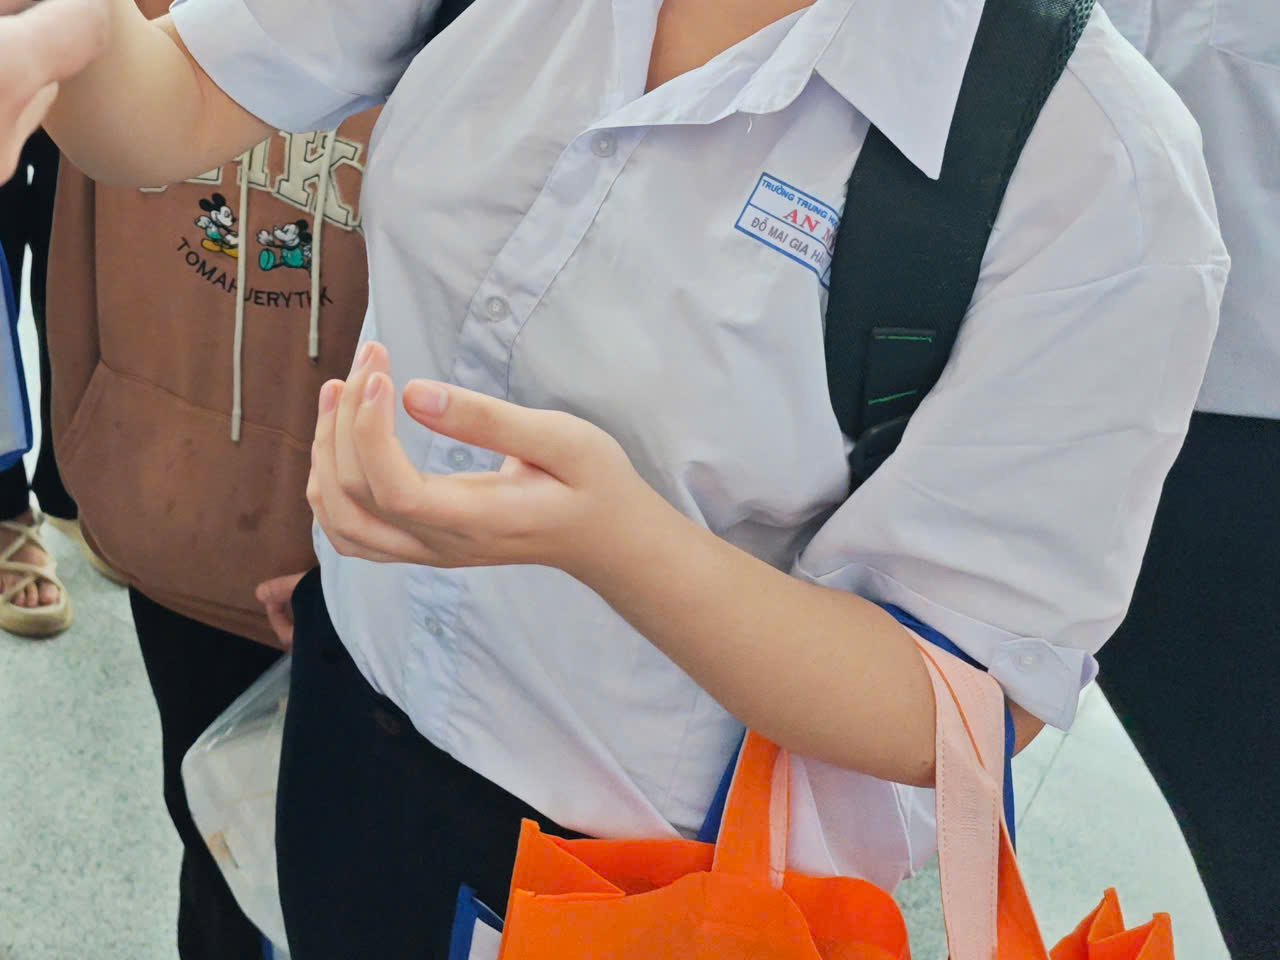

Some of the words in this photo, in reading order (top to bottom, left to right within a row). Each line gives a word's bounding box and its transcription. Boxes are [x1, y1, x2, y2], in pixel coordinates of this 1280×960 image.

[761, 179, 795, 202] TRƯỜNG
[797, 197, 828, 218] TRUNG
[750, 217, 769, 232] ĐỖ
[768, 226, 789, 244] MAI
[789, 238, 809, 256] GIA
[783, 208, 821, 233] AN
